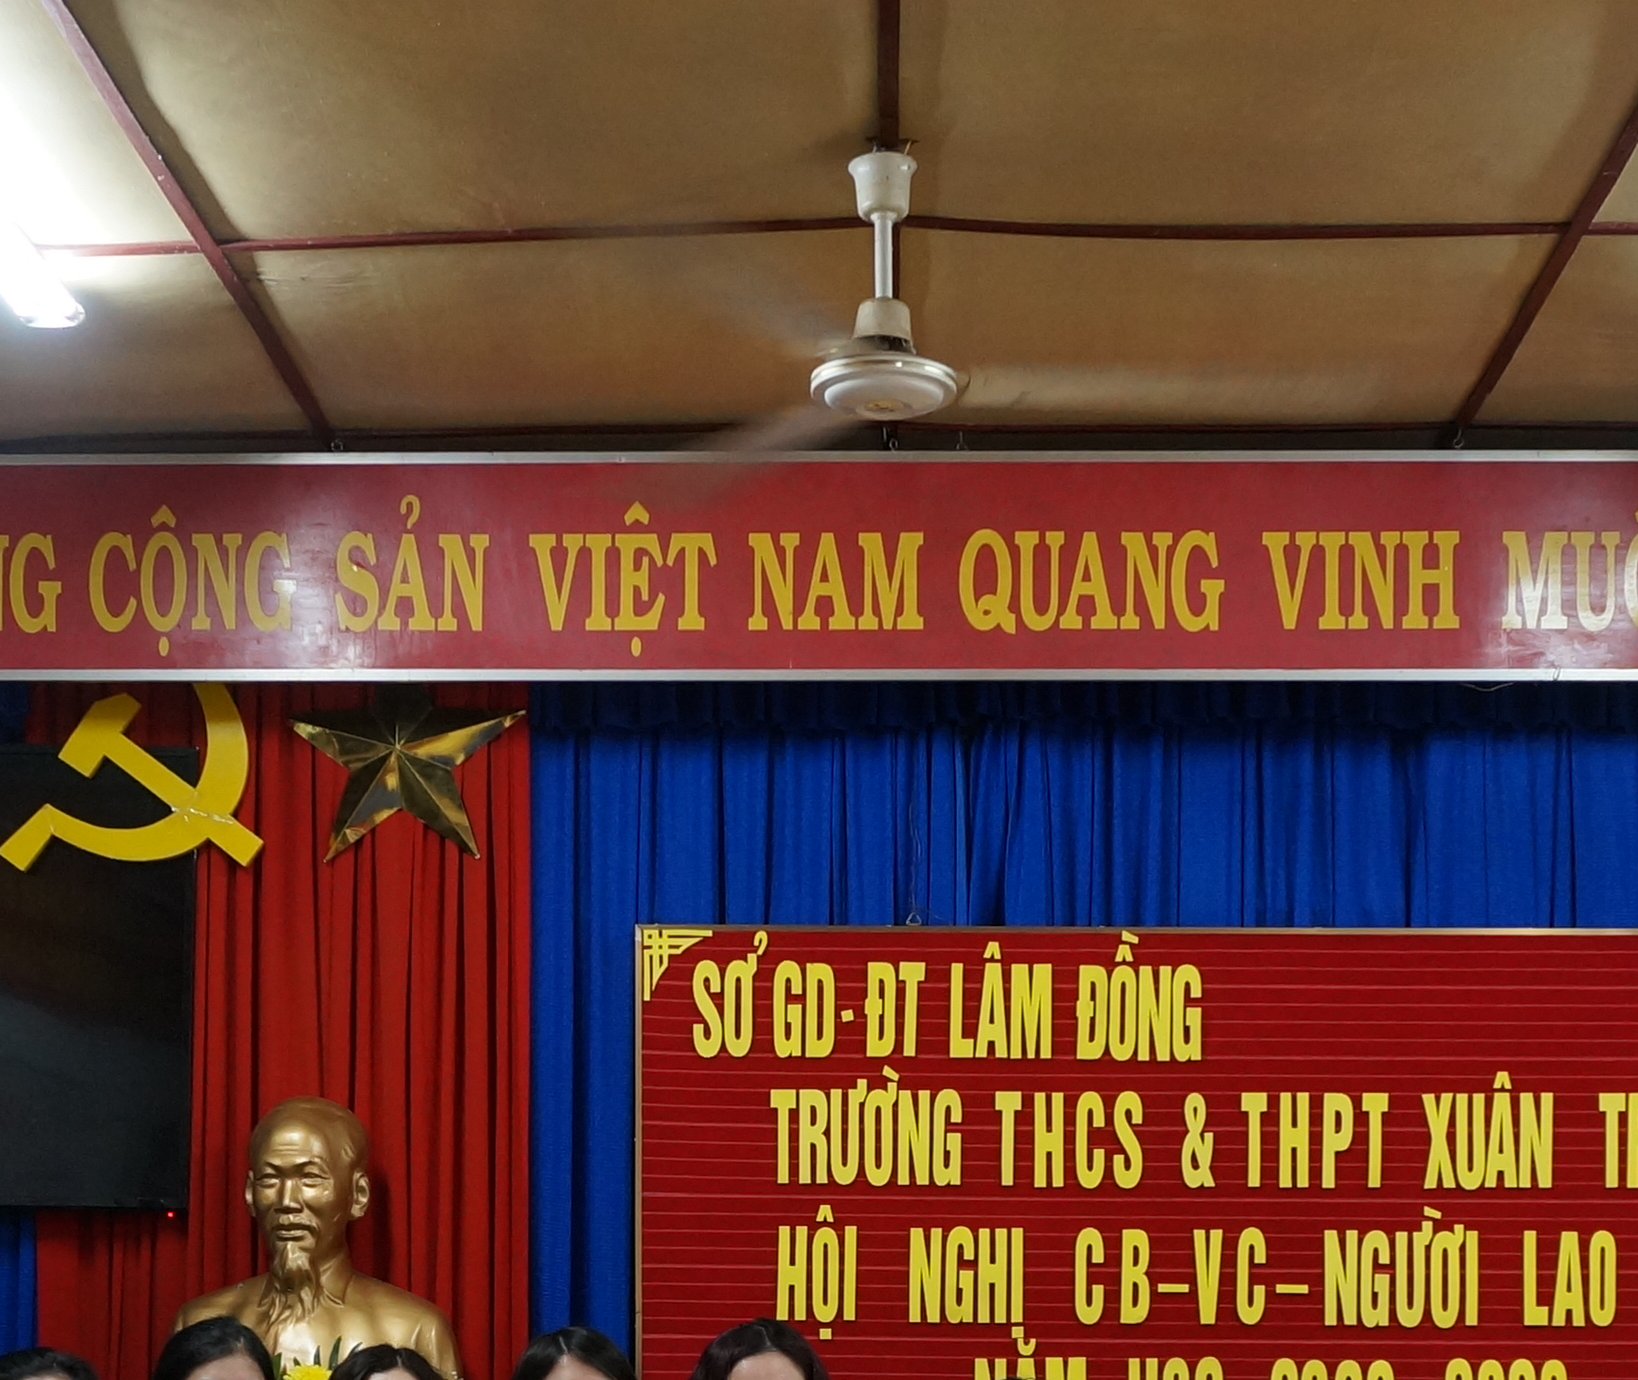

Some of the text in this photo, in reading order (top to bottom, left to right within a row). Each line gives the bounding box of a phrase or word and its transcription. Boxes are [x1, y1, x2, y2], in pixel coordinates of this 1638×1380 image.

[91, 505, 294, 656] CỘNG
[338, 497, 488, 631] SẢN
[531, 505, 715, 654] VIỆT
[749, 533, 923, 629] NAM
[960, 530, 1224, 632] QUANG
[1263, 532, 1458, 628] VINH
[692, 929, 768, 1058] SỞ
[950, 942, 1052, 1059] LÂM
[1076, 929, 1201, 1061] ĐỒNG
[771, 1067, 962, 1186] TRƯỜNG
[995, 1091, 1143, 1188] THCS
[1182, 1093, 1214, 1188] &
[1241, 1092, 1388, 1188] THPT
[1423, 1072, 1553, 1190] XUÂN
[776, 1205, 857, 1339] HỘI
[909, 1227, 1024, 1340] NGHỊ
[1523, 1231, 1616, 1326] LAO
